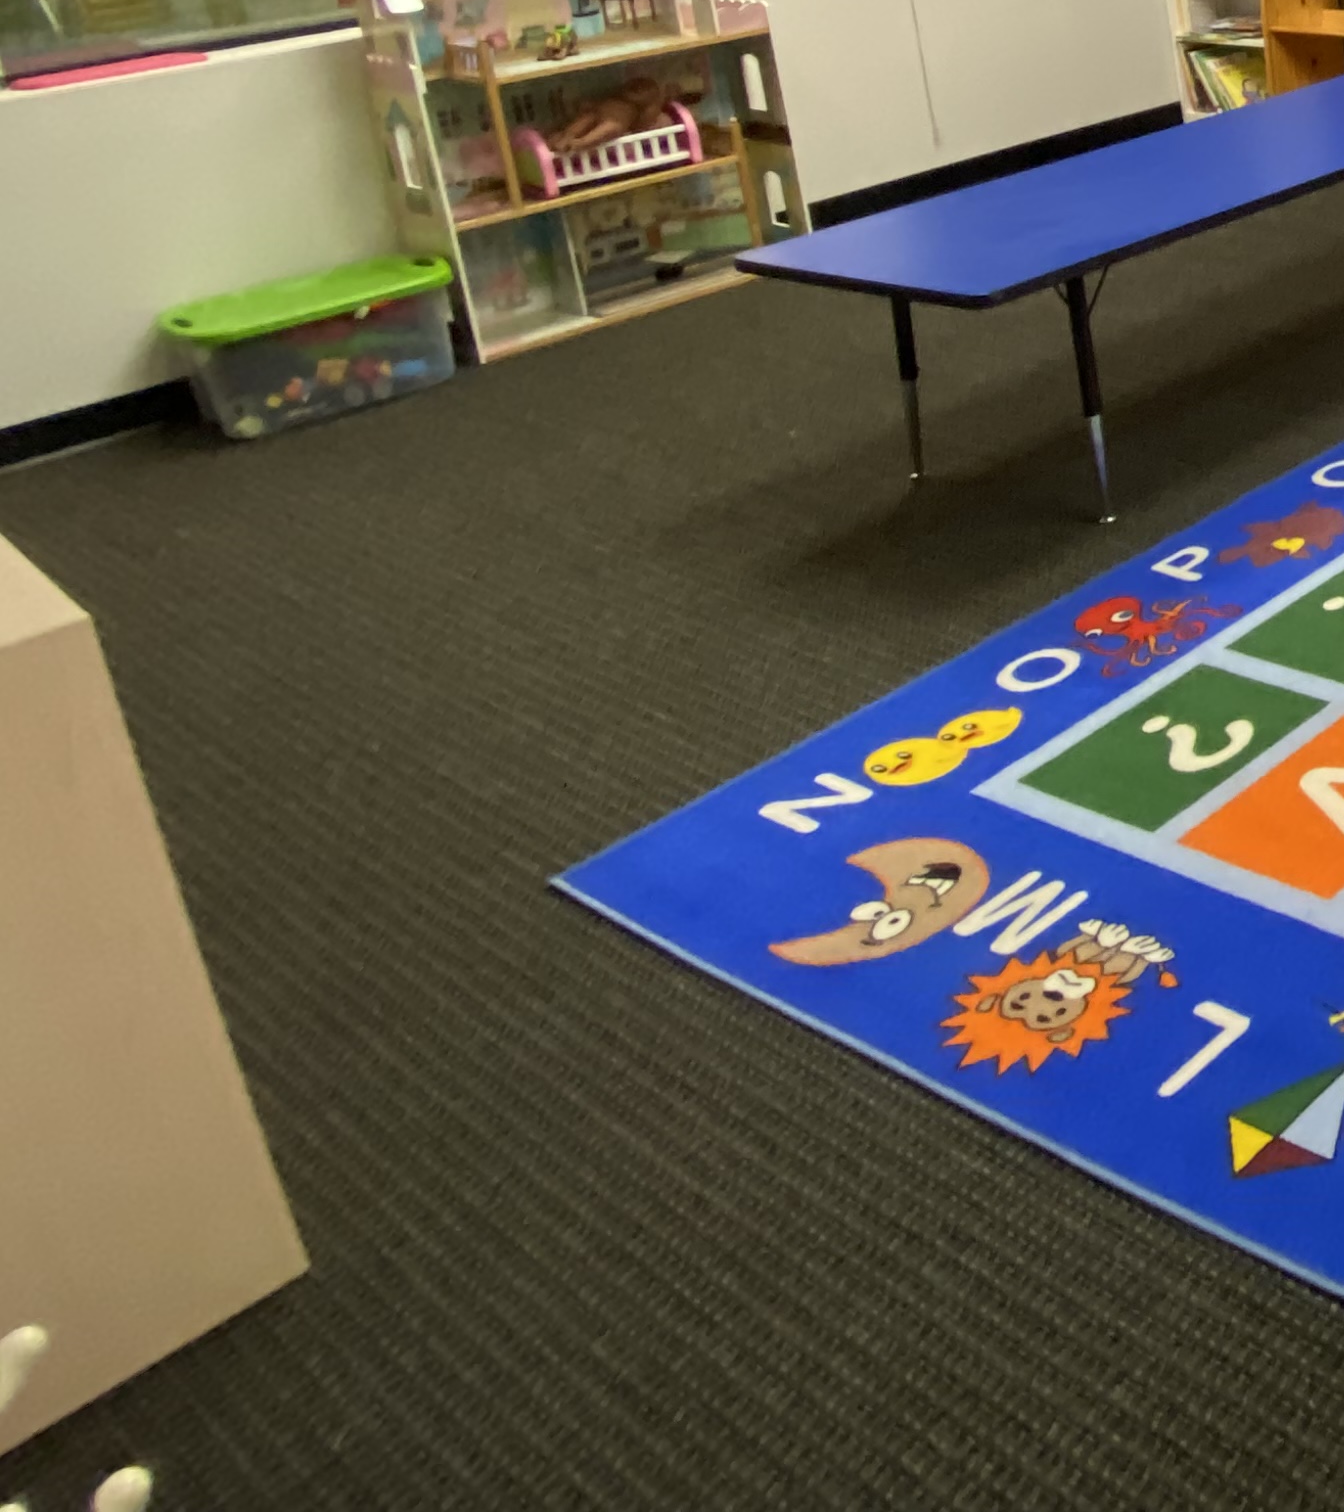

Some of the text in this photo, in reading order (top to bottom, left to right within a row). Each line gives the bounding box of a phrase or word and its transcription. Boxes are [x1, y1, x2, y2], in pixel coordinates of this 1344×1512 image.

[758, 773, 873, 833] N
[996, 648, 1080, 692] O
[1153, 547, 1209, 581] P
[1142, 716, 1255, 774] ?
[952, 871, 1087, 956] M
[1159, 1002, 1250, 1096] L
